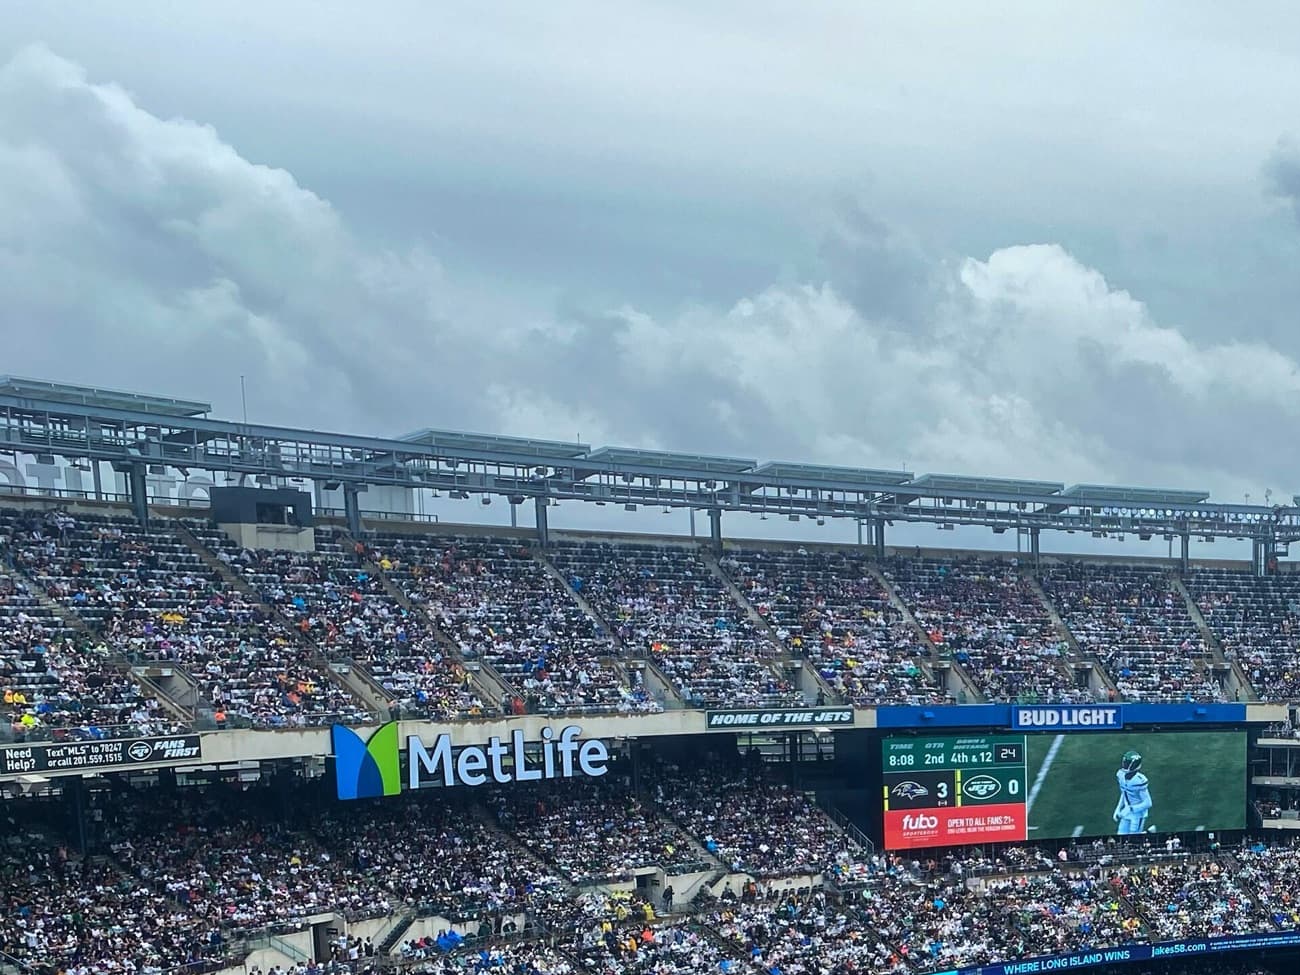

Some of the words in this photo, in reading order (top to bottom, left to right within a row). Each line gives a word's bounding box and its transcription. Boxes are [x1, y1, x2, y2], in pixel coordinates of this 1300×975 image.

[711, 713, 758, 725] HOME
[760, 713, 777, 723] OF
[784, 713, 814, 723] THE
[815, 712, 851, 722] JETS
[1019, 709, 1060, 726] BUD
[1062, 709, 1115, 725] LIGHT
[46, 748, 64, 758] Text
[91, 744, 99, 754] to
[100, 743, 122, 753] 78247
[154, 740, 186, 750] FANS
[6, 748, 31, 759] Need
[164, 747, 199, 758] FIRST
[407, 726, 608, 789] MetLife
[889, 755, 914, 766] 8:08
[924, 753, 945, 765] 2nd
[951, 753, 968, 764] 4th
[980, 752, 992, 763] 12
[1000, 749, 1016, 759] 24
[7, 759, 36, 772] Help?
[48, 759, 57, 767] or
[58, 757, 72, 766] call
[73, 754, 122, 765] 201.559.1515
[937, 782, 948, 798] 3
[1008, 779, 1018, 795] 0
[902, 814, 938, 830] fubo
[947, 818, 964, 828] OPEN
[965, 818, 974, 827] TO
[974, 817, 986, 826] ALL
[987, 816, 1002, 825] FANS
[1151, 942, 1206, 958] jakes58.com
[1003, 962, 1040, 975] WHERE
[1041, 958, 1068, 971] LONG
[1070, 953, 1103, 967] ISLAND
[1104, 950, 1130, 962] WINS
